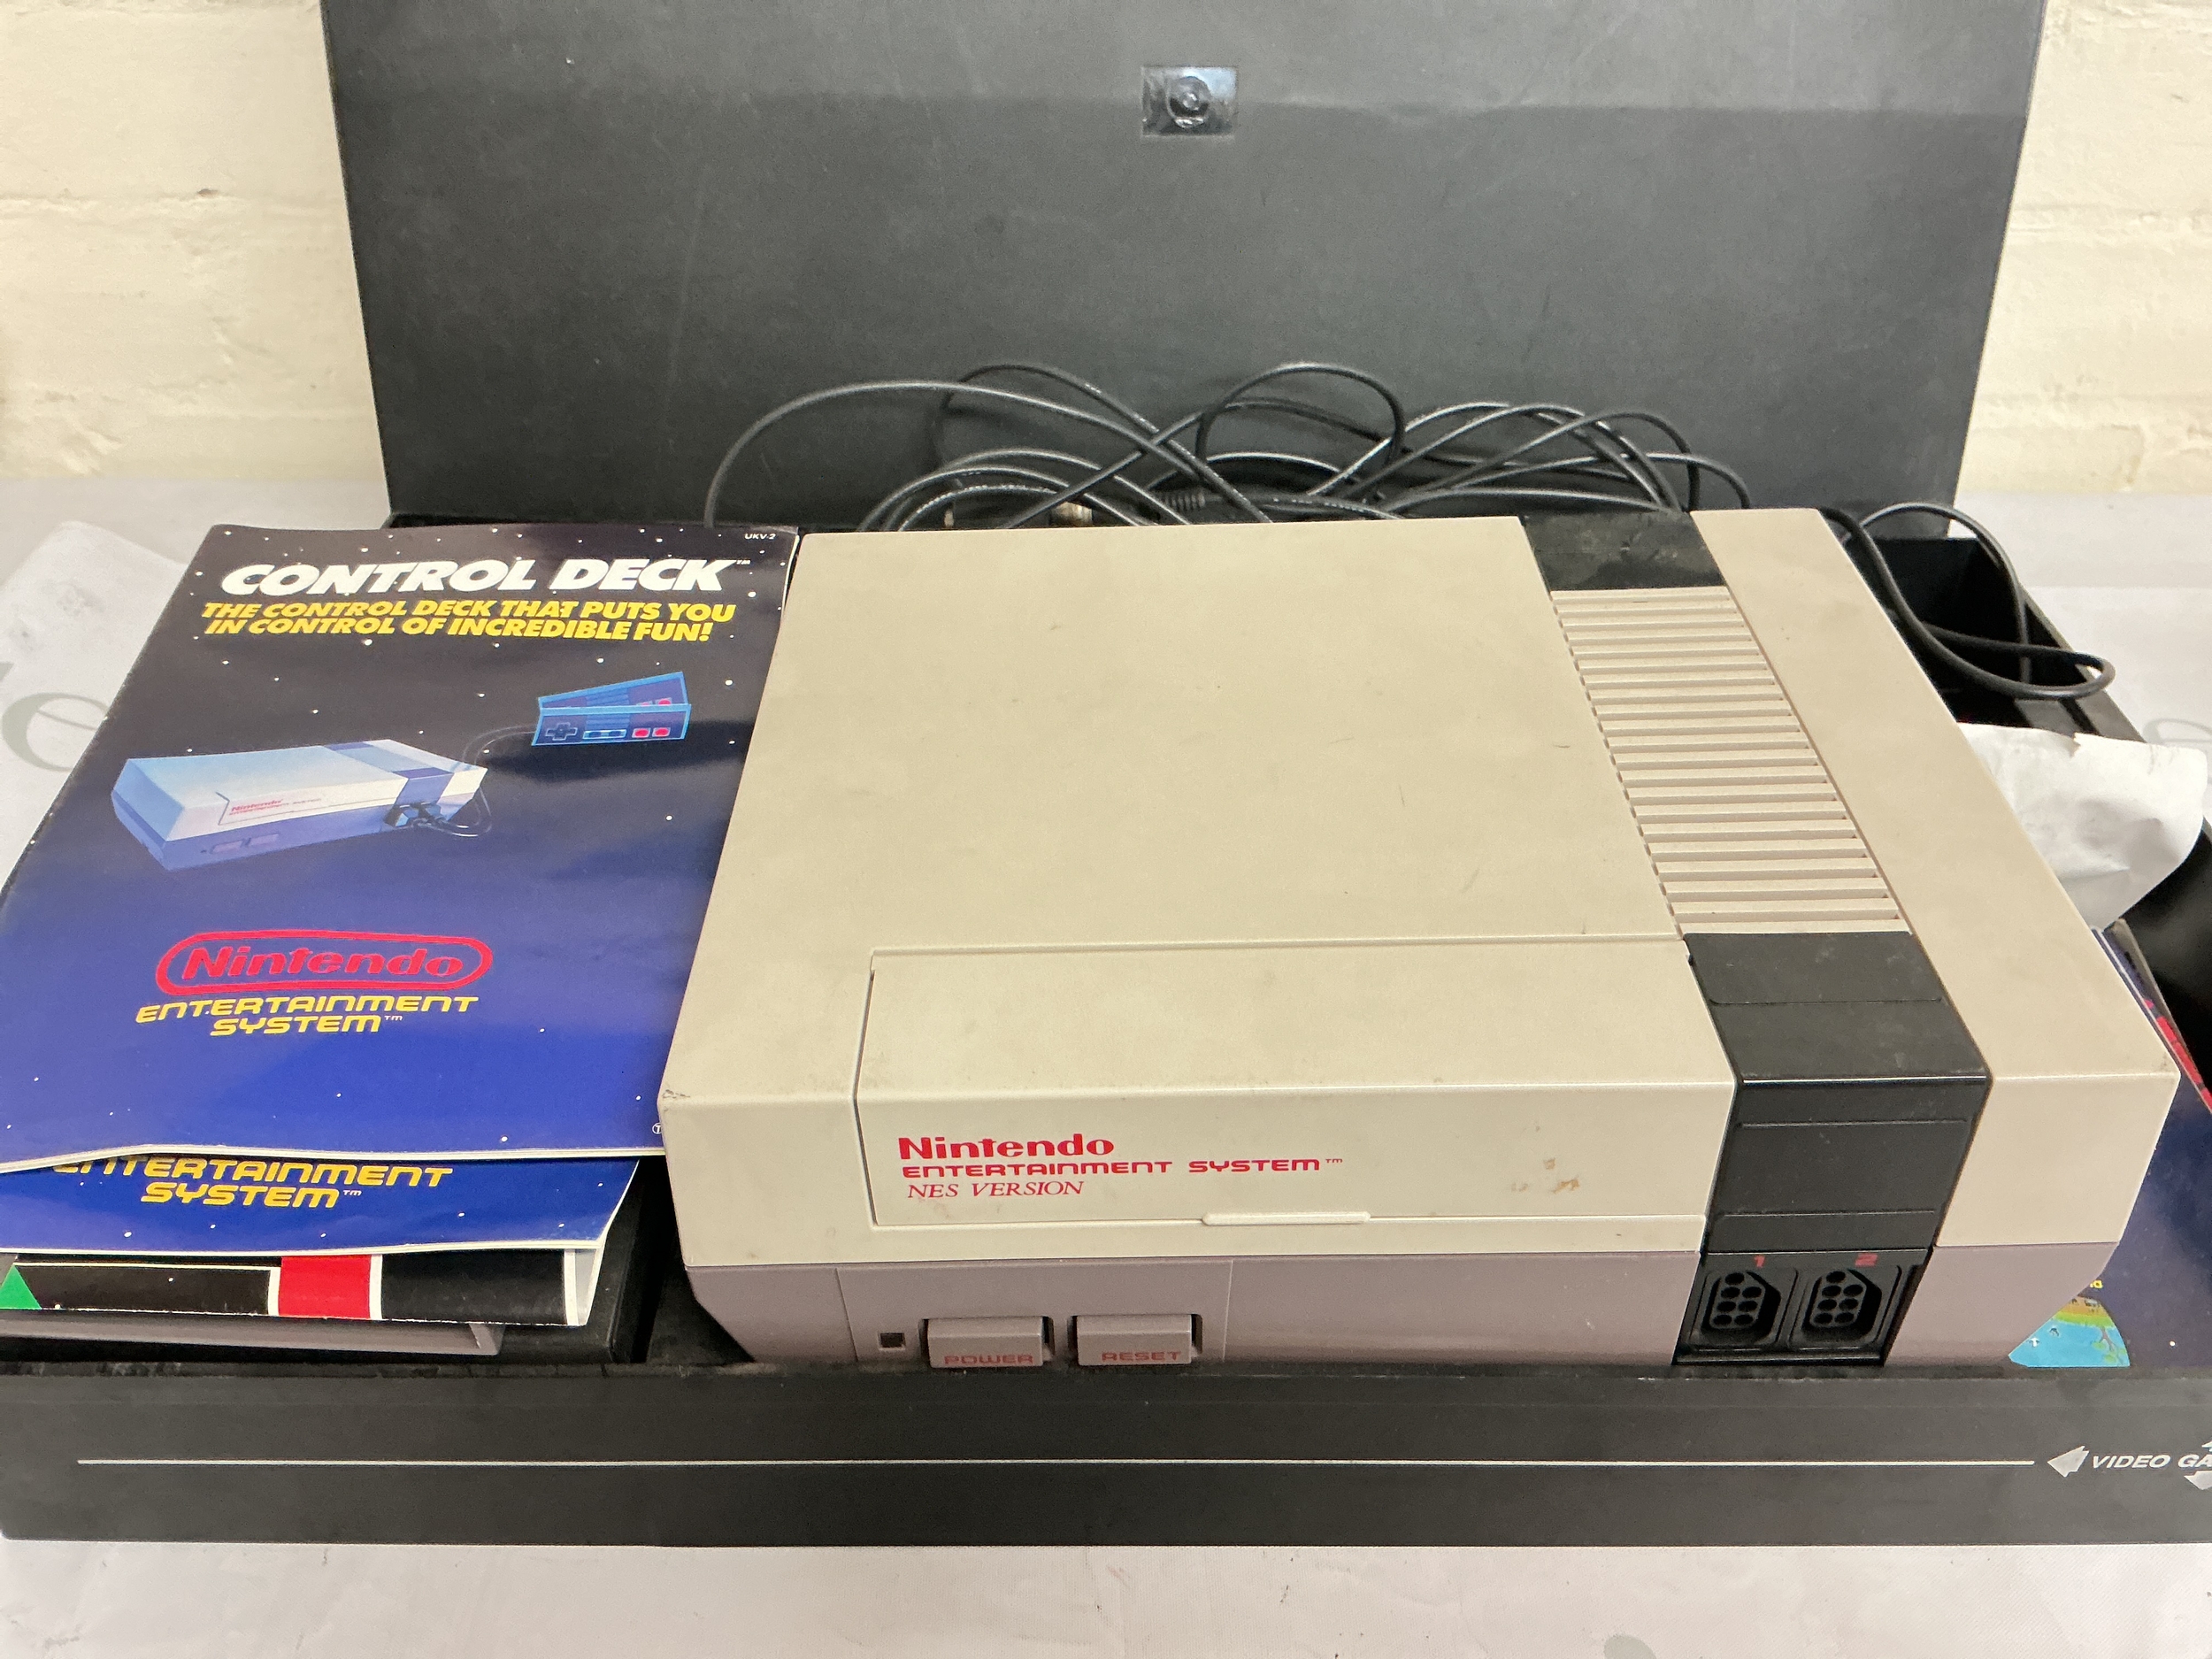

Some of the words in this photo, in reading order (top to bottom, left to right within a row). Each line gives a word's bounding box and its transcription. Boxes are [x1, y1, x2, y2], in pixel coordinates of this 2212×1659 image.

[221, 559, 536, 596] CONTROL
[549, 558, 735, 592] DECK
[201, 602, 263, 618] THE
[262, 601, 407, 618] CONTROL
[411, 600, 498, 618] DECK
[500, 600, 578, 618] THAT
[580, 602, 662, 620] PUTS
[667, 603, 737, 623] YOU
[204, 618, 248, 634] IN
[248, 618, 396, 635] CONTROL
[401, 618, 449, 635] OF
[446, 618, 633, 641] INCREDIBLE
[633, 621, 714, 642] FUN!
[181, 945, 465, 980] Nintendo
[134, 995, 480, 1024] ENTERTAINMENT
[210, 1015, 384, 1036] SYSTEM
[898, 1133, 1115, 1160] Nintendo
[902, 1161, 1173, 1179] ENTERTAINMENT
[1188, 1158, 1321, 1173] SYSTEM
[141, 1182, 341, 1208] SYSTEM
[907, 1183, 959, 1199] NES
[972, 1180, 1085, 1197] VERSION
[943, 1354, 1034, 1364] POWER
[1101, 1351, 1182, 1362] RESET
[2093, 1455, 2171, 1469] VIDEO
